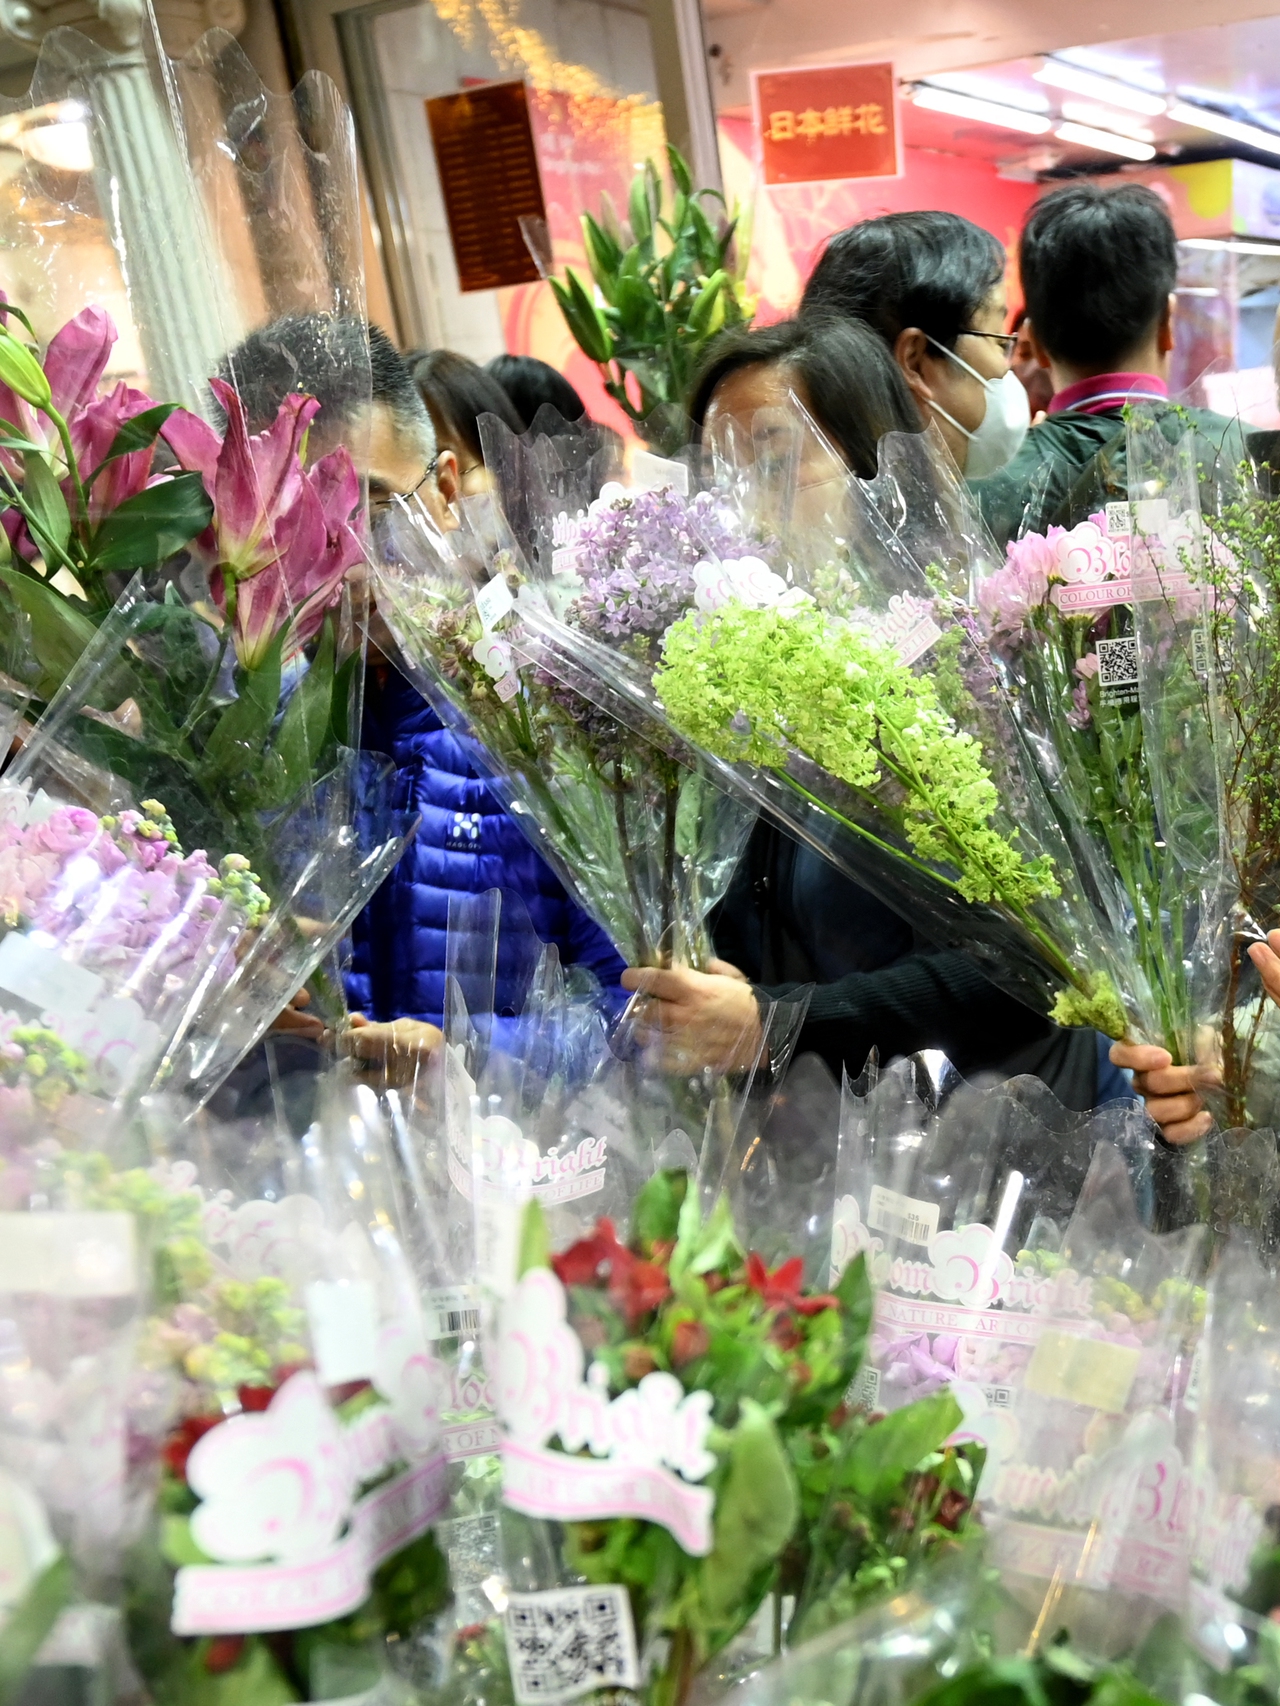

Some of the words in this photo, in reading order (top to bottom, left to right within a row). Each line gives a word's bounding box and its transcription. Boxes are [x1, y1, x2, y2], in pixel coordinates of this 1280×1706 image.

[767, 103, 888, 143] 日本鮮花
[1060, 587, 1114, 605] COLOUR
[569, 1176, 603, 1193] LIFE
[887, 1305, 958, 1327] NATURE
[975, 1318, 1010, 1333] ART
